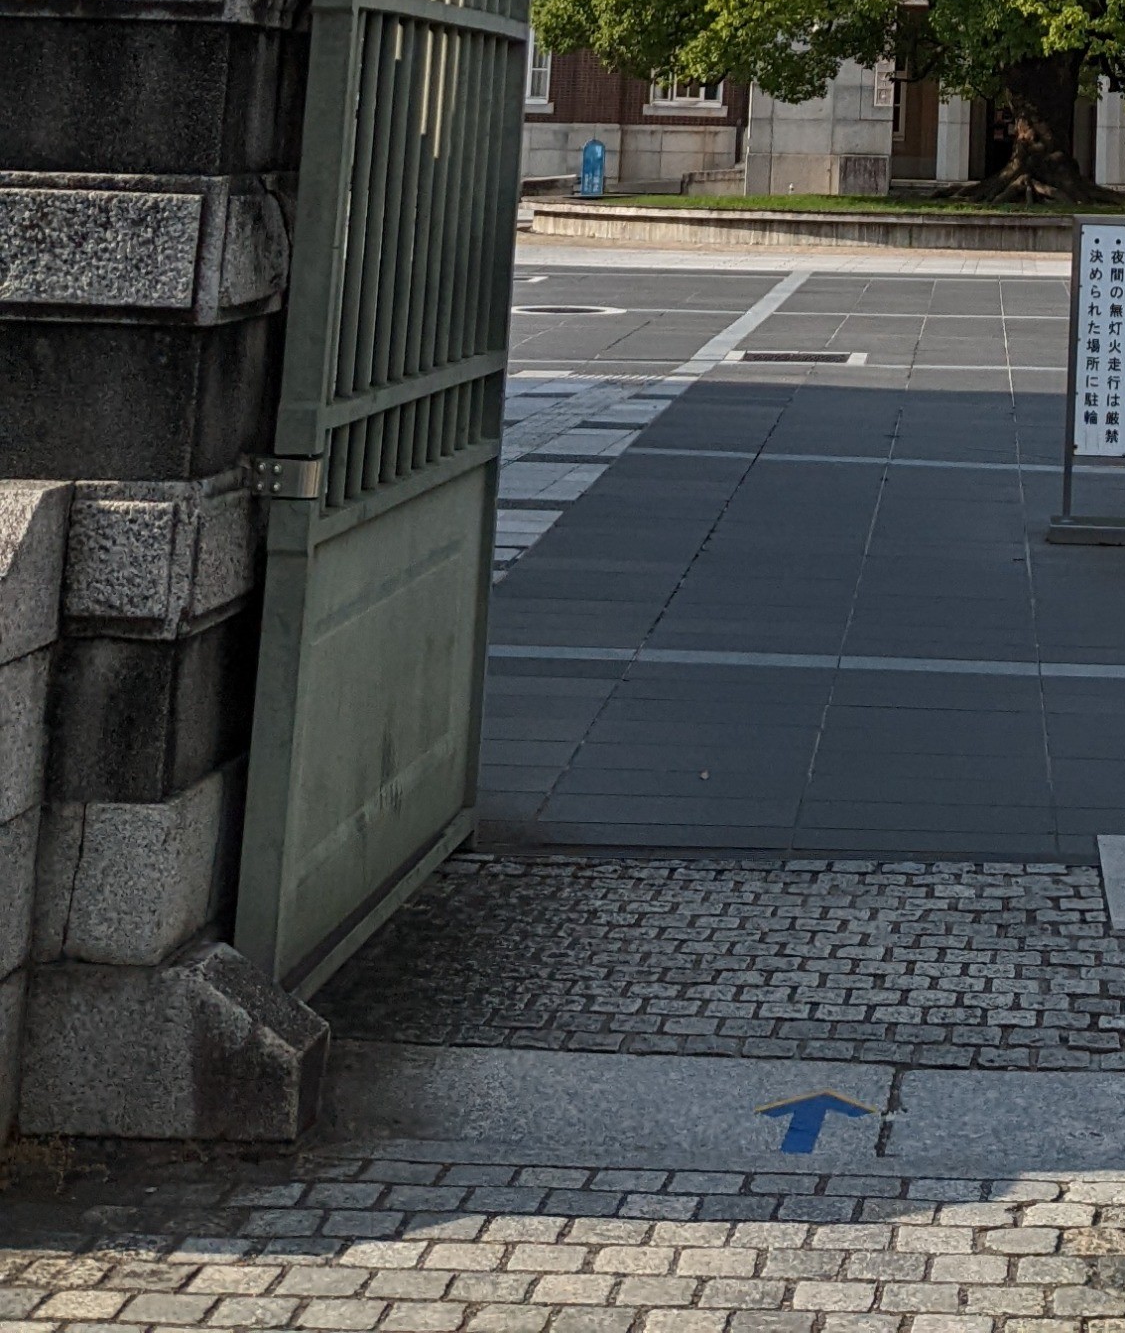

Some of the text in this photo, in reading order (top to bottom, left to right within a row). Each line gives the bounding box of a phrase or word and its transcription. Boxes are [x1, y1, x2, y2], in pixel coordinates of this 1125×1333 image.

[1084, 249, 1103, 425] 決められた場所に駐輪
[1105, 249, 1125, 444] 夜間の無灯火走行は厳禁
